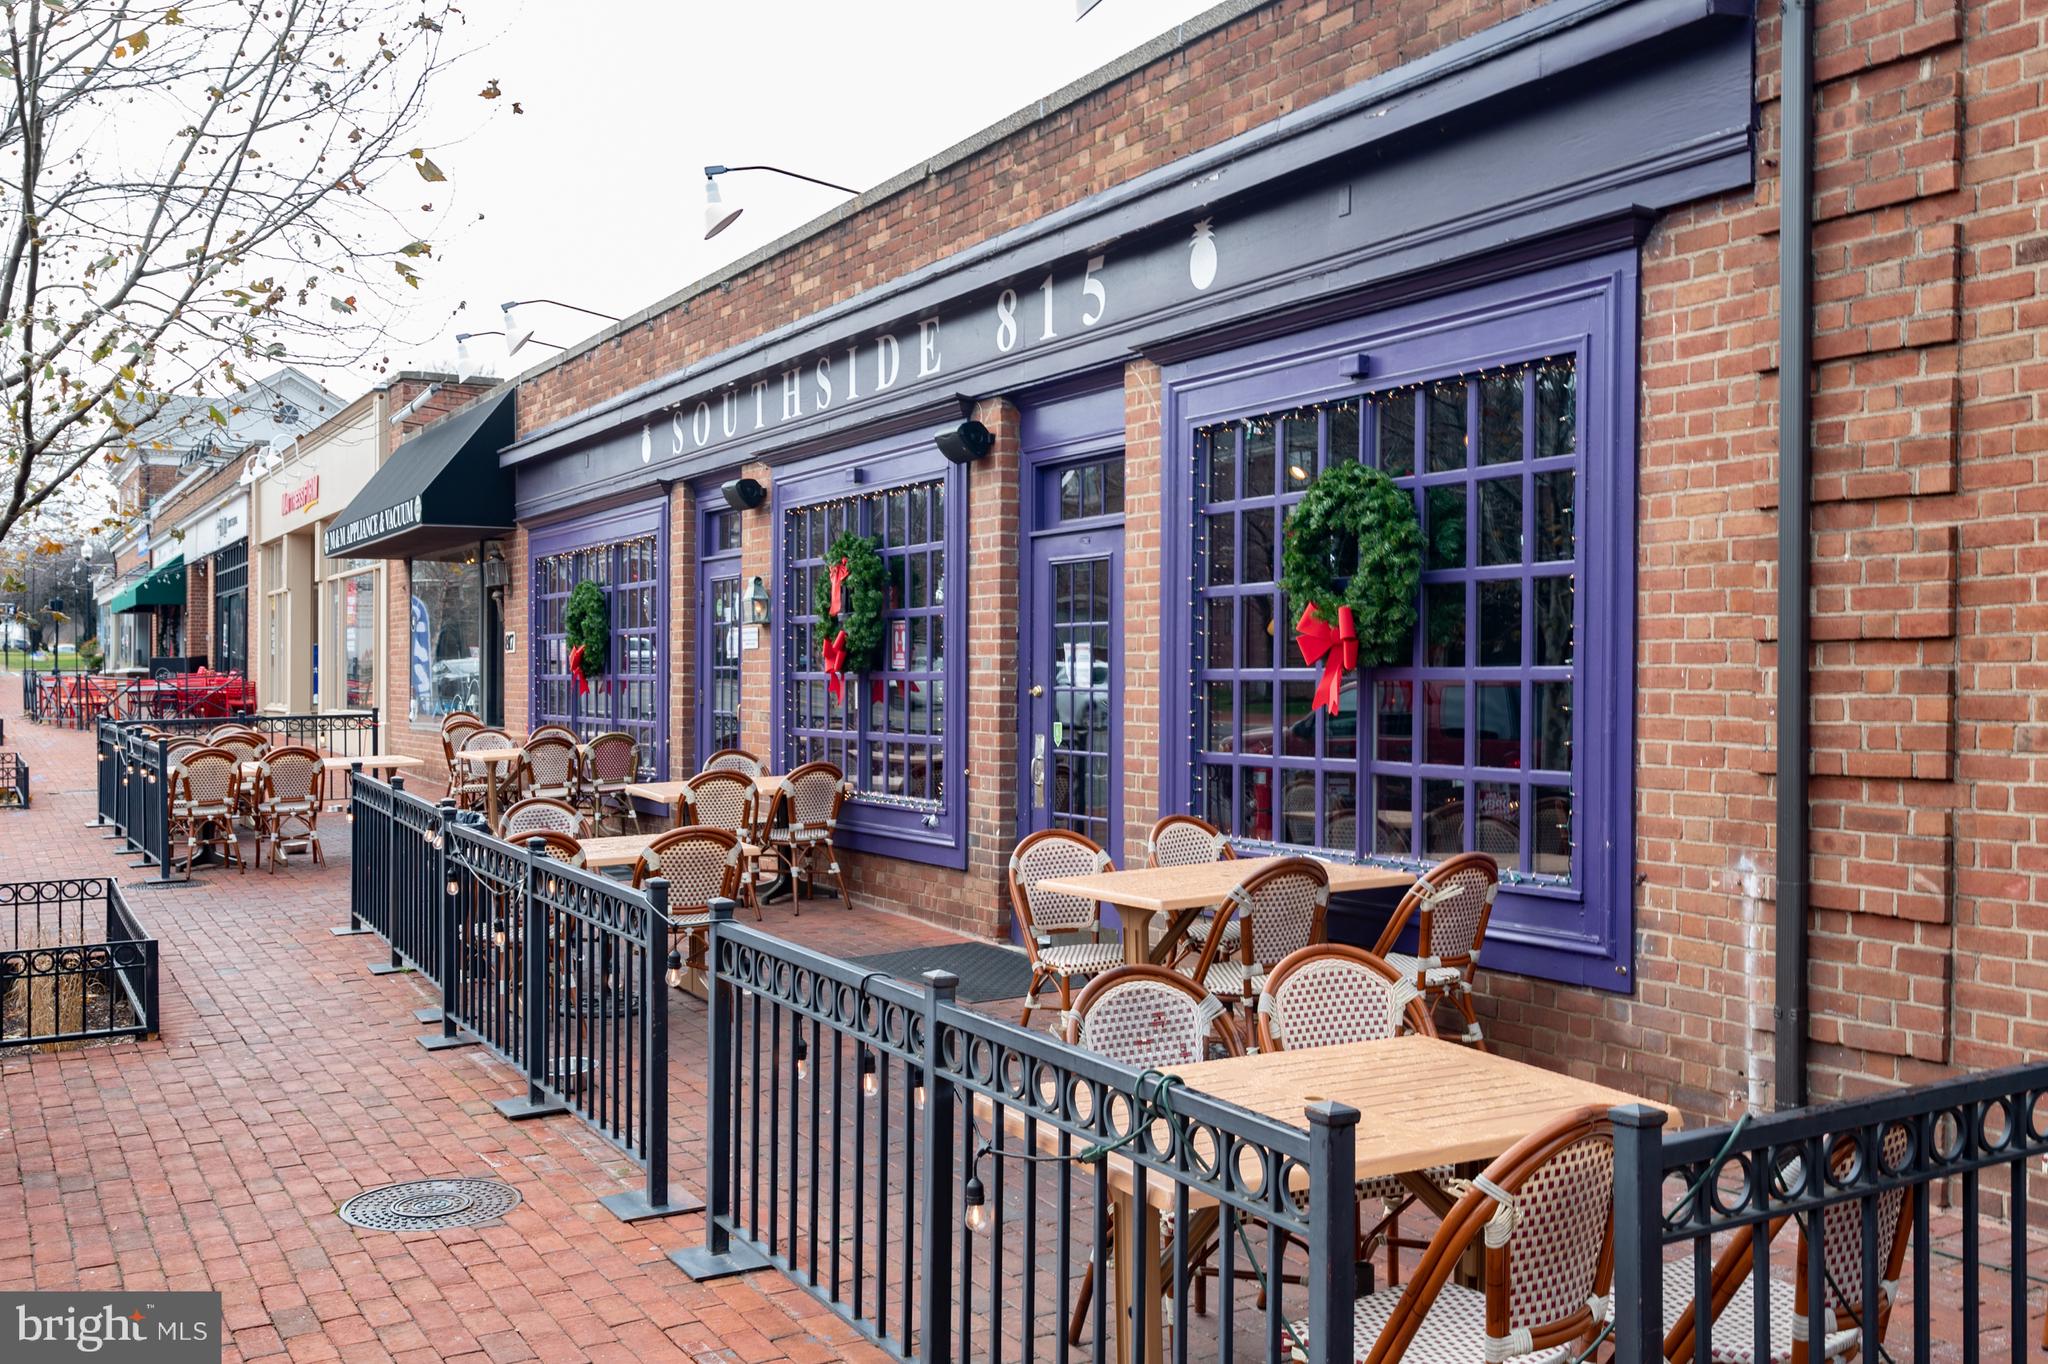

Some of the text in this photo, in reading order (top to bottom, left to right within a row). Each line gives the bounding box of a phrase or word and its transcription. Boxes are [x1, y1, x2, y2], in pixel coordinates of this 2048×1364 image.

[672, 256, 1107, 455] SOUTHSIDE 815
[346, 514, 379, 544] APPLIANCE
[379, 511, 385, 534] &
[385, 500, 414, 531] VACUUM
